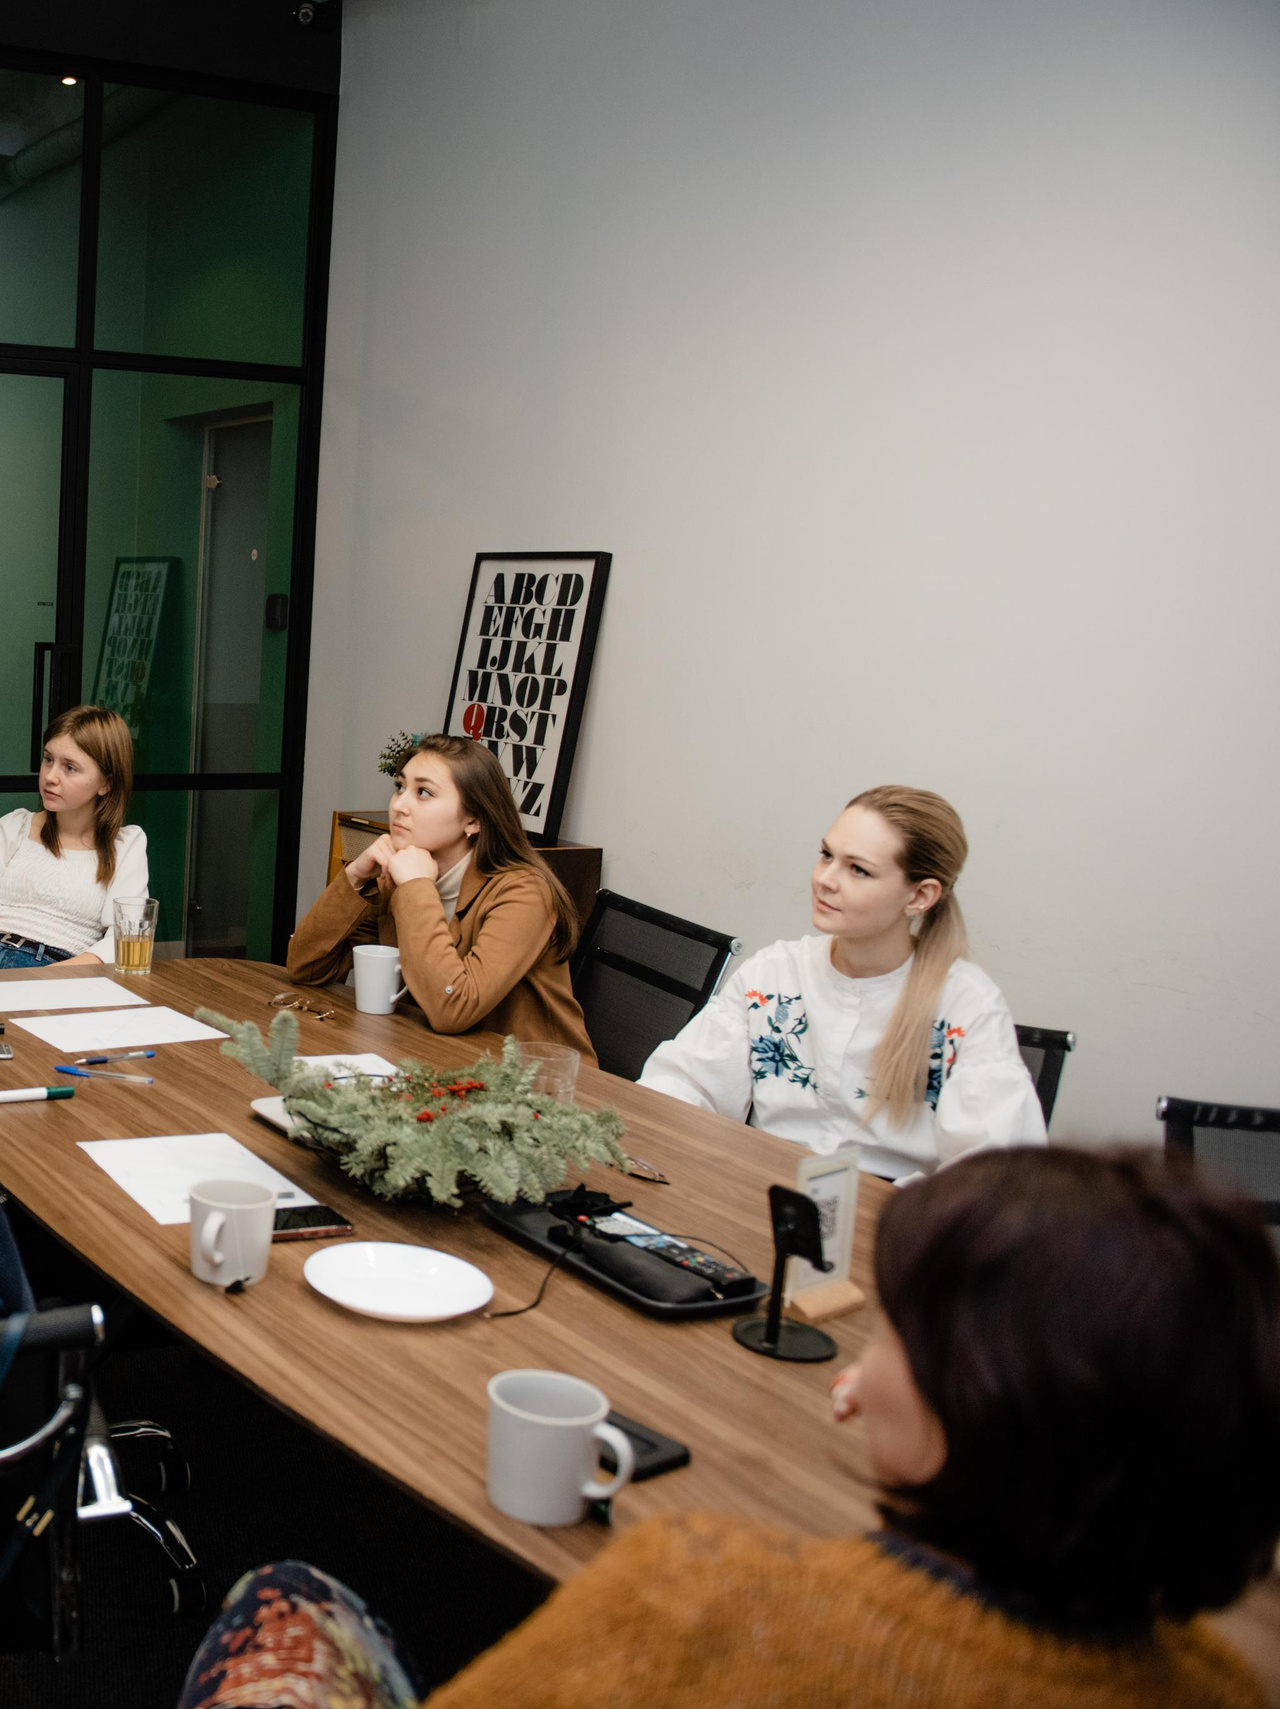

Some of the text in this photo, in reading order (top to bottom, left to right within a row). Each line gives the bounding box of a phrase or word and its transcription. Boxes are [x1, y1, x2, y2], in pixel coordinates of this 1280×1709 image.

[483, 572, 584, 607] ABCD
[477, 605, 578, 643] EFGH
[475, 637, 564, 678] IJKL
[461, 669, 568, 712] MNOP
[462, 703, 557, 746] QRST
